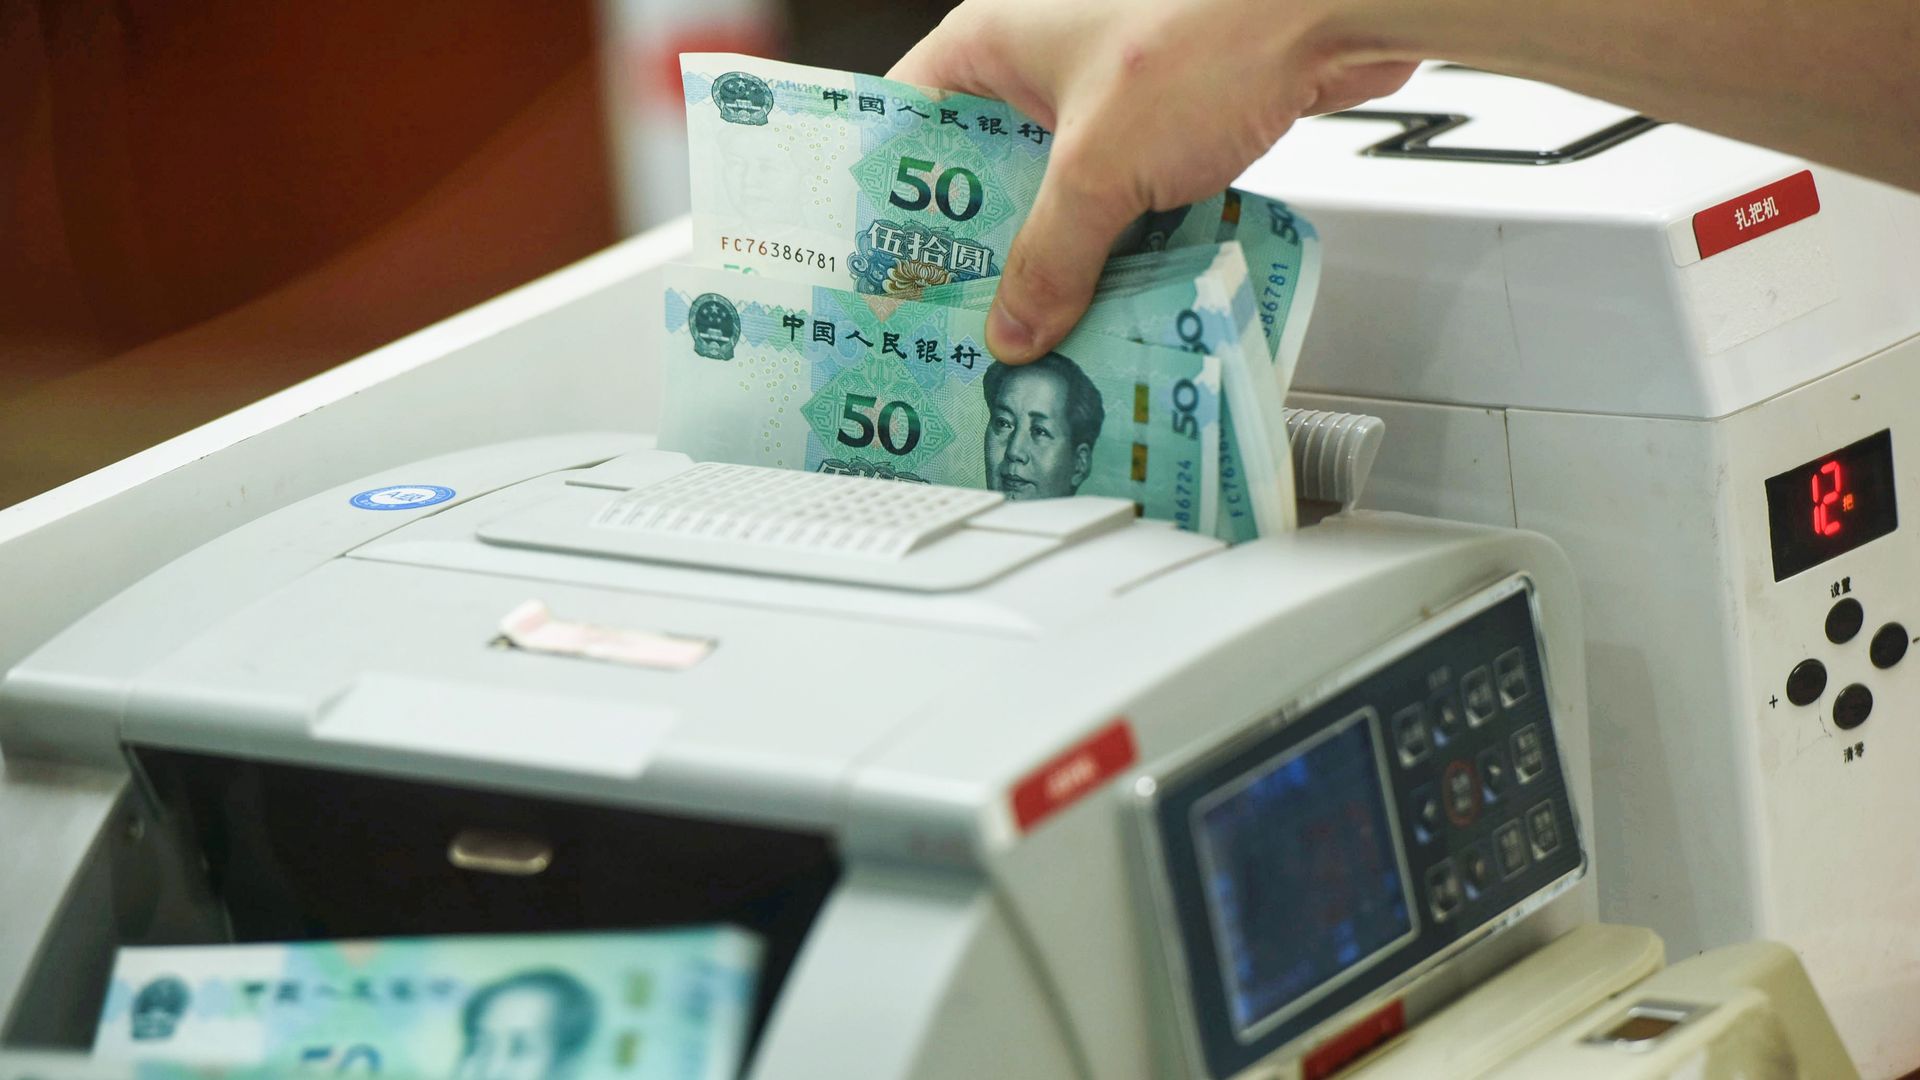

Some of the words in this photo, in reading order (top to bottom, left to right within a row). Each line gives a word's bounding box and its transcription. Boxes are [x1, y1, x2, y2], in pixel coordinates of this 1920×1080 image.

[822, 90, 1052, 145] 中国人民银行
[888, 156, 984, 222] 50
[1734, 196, 1780, 231] 扎把机
[720, 235, 837, 273] FC76386781
[866, 221, 995, 278] 伍拾圆
[782, 314, 982, 370] 中国人民银行
[836, 392, 922, 456] 50
[1172, 378, 1200, 441] 50
[1811, 460, 1841, 537] 12
[1830, 576, 1852, 598] 设置
